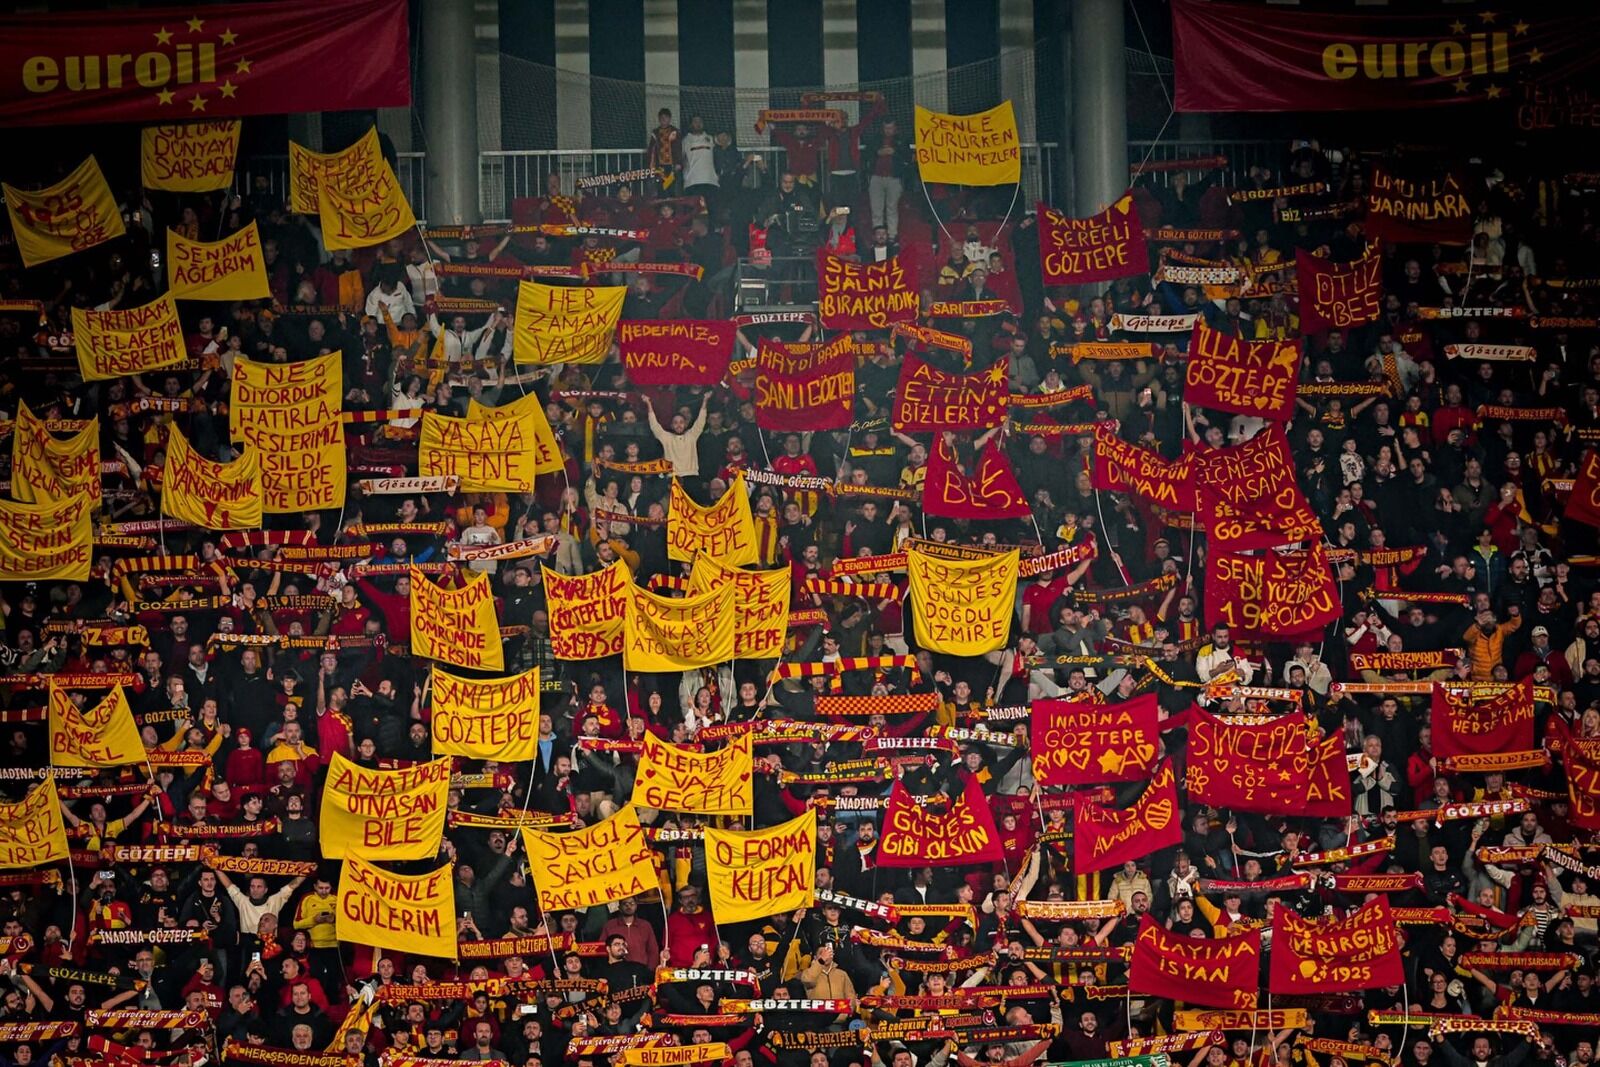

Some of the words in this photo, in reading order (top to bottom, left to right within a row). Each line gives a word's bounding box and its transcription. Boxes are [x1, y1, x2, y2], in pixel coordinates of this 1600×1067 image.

[1322, 33, 1509, 79] euroil
[22, 43, 216, 93] euroil
[337, 204, 401, 239] 1925
[1045, 243, 1128, 275] GÖZTEPE
[548, 288, 595, 313] HER
[934, 304, 962, 314] SARI
[528, 310, 608, 333] ZAMAN
[751, 313, 804, 323] GÖZTEPE
[1439, 307, 1513, 318] GÖZTEPE
[1126, 316, 1185, 329] Göztepe
[1464, 344, 1523, 356] Göztepe
[265, 363, 305, 385] NE
[1186, 358, 1289, 399] GÖZTEPE
[239, 400, 331, 429] HATIRLA
[378, 479, 438, 489] Göztepe
[788, 474, 827, 489] GÖZTEPE
[465, 539, 533, 561] GÖZTEPE
[919, 561, 982, 585] 1925
[433, 709, 532, 745] GÖZTEPE
[878, 738, 939, 749] GÖZTEPE
[1045, 729, 1145, 748] GÖZTEPE
[1446, 802, 1522, 818] GÖZTEPE
[716, 841, 733, 865] O
[743, 830, 811, 866] FORMA
[1347, 878, 1364, 889] BİZ
[343, 890, 441, 938] GÜLERİM
[149, 928, 194, 943] GÖZTEPE
[674, 969, 756, 983] GÖZTEPE
[1160, 956, 1230, 983] İSYAN
[1331, 966, 1371, 982] 1925
[750, 1000, 834, 1009] GÖZTEPE
[1222, 1012, 1285, 1026] GAGS
